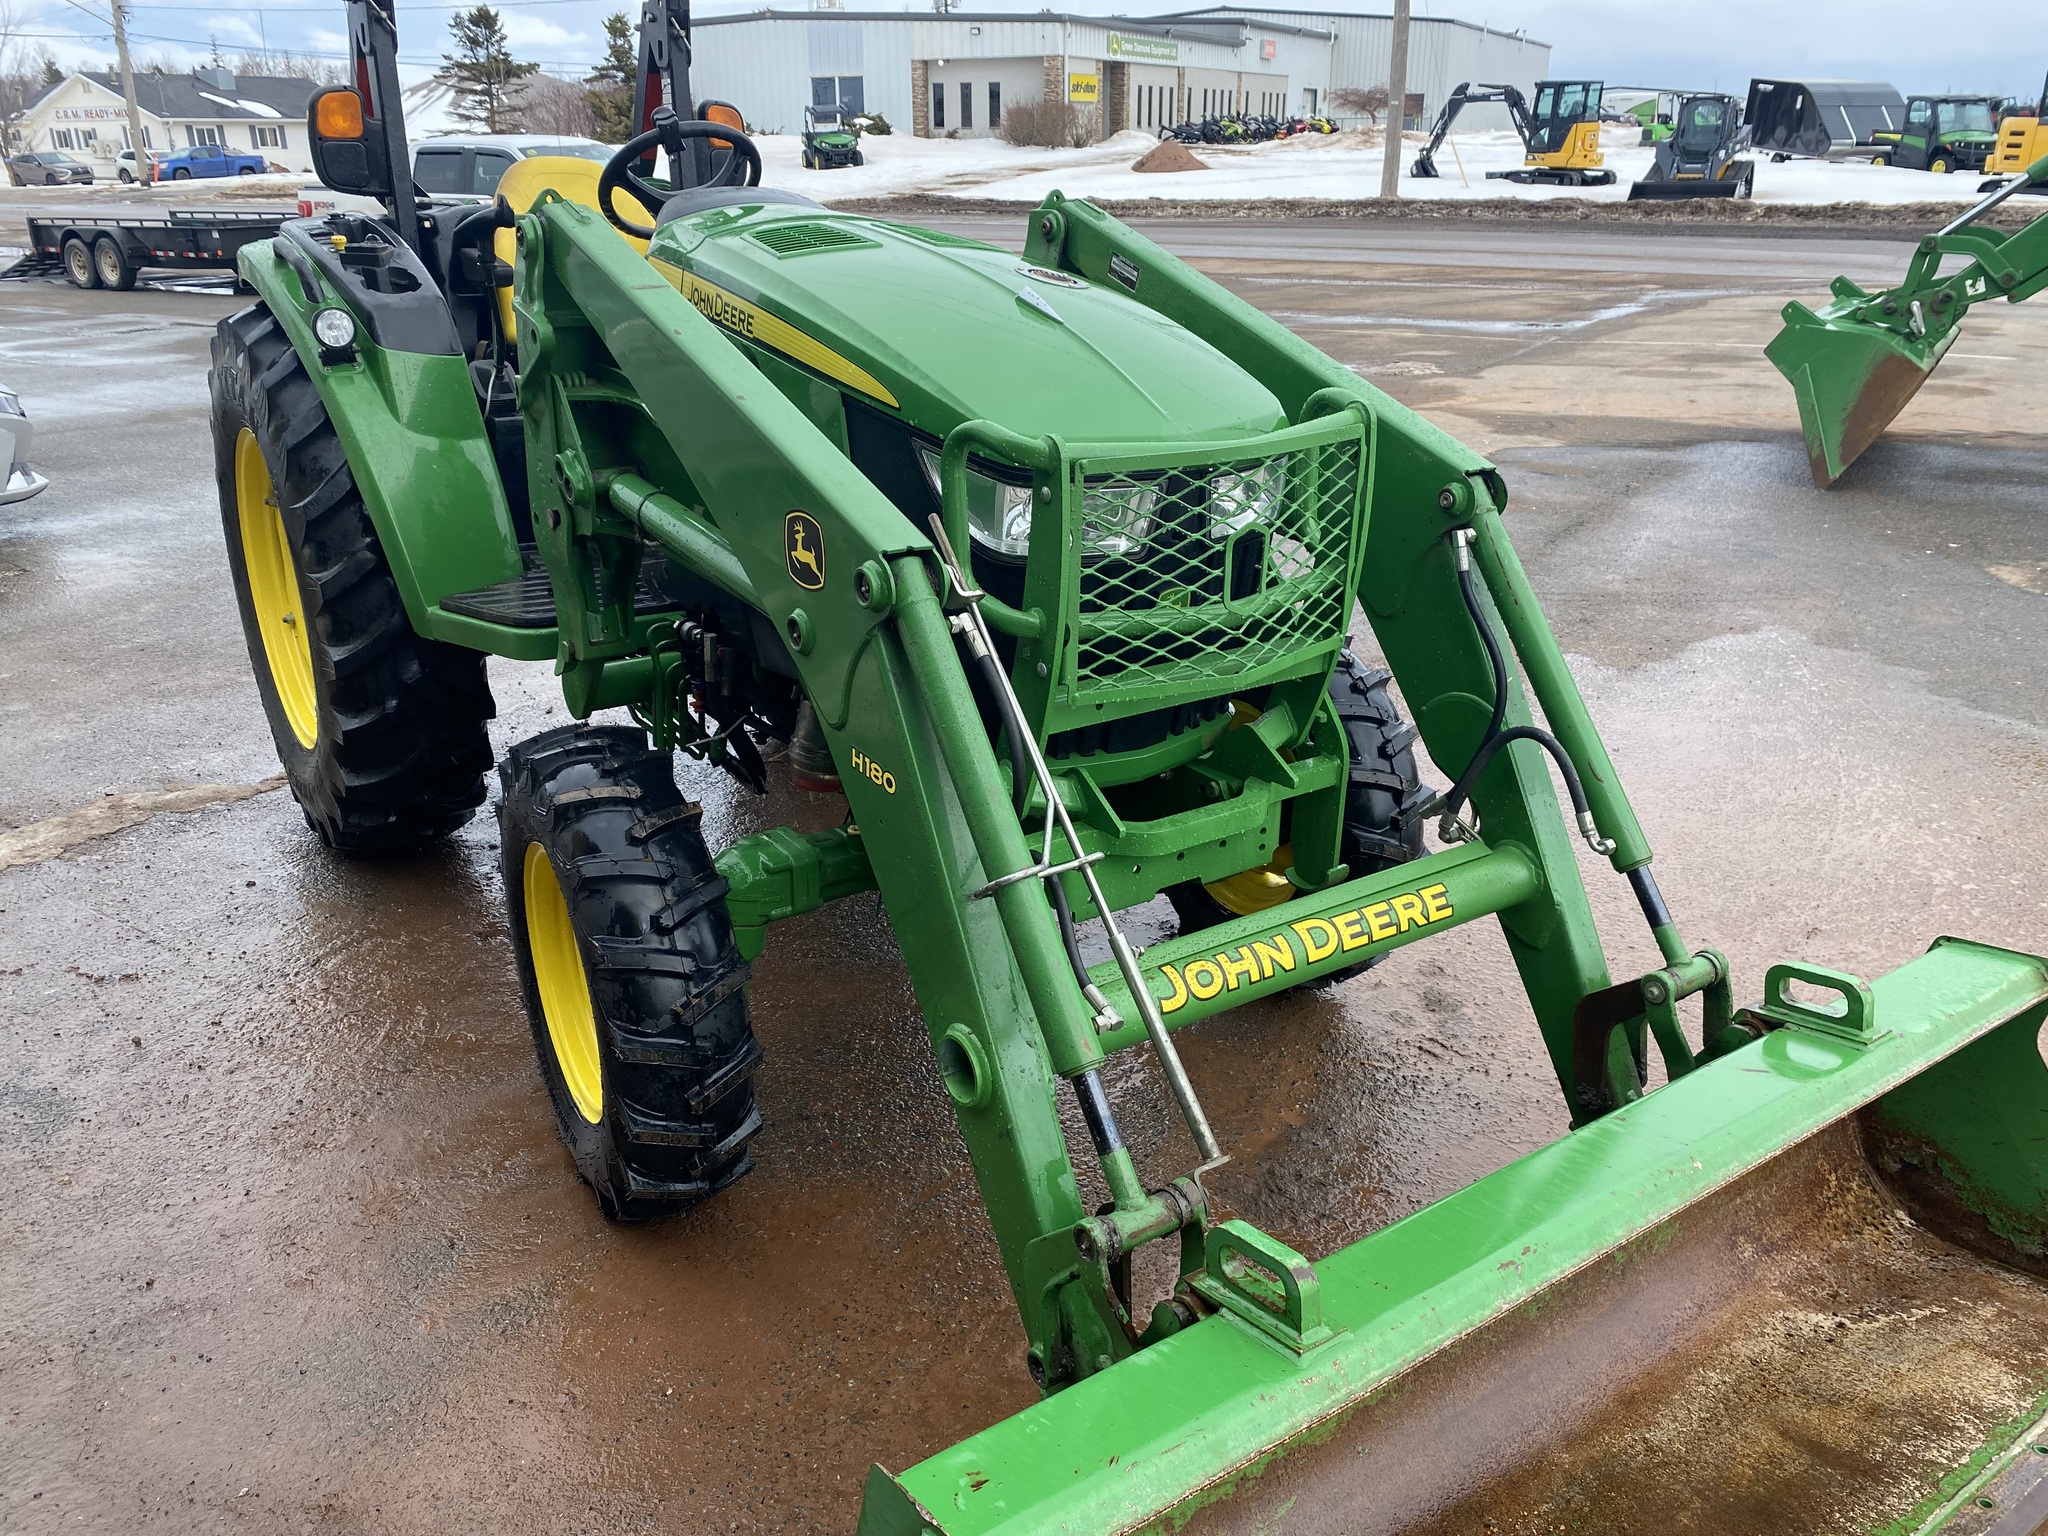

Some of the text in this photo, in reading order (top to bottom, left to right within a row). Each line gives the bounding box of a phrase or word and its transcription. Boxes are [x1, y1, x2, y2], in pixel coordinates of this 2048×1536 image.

[1121, 41, 1133, 51] Green
[1134, 43, 1150, 53] Diamond
[1152, 45, 1169, 56] Equipment
[1071, 81, 1096, 93] ski-doo
[55, 110, 82, 120] C.R.M.
[687, 281, 754, 336] JOHN DEERE
[851, 747, 896, 795] H180
[1159, 883, 1454, 1015] JOHN DEERE
